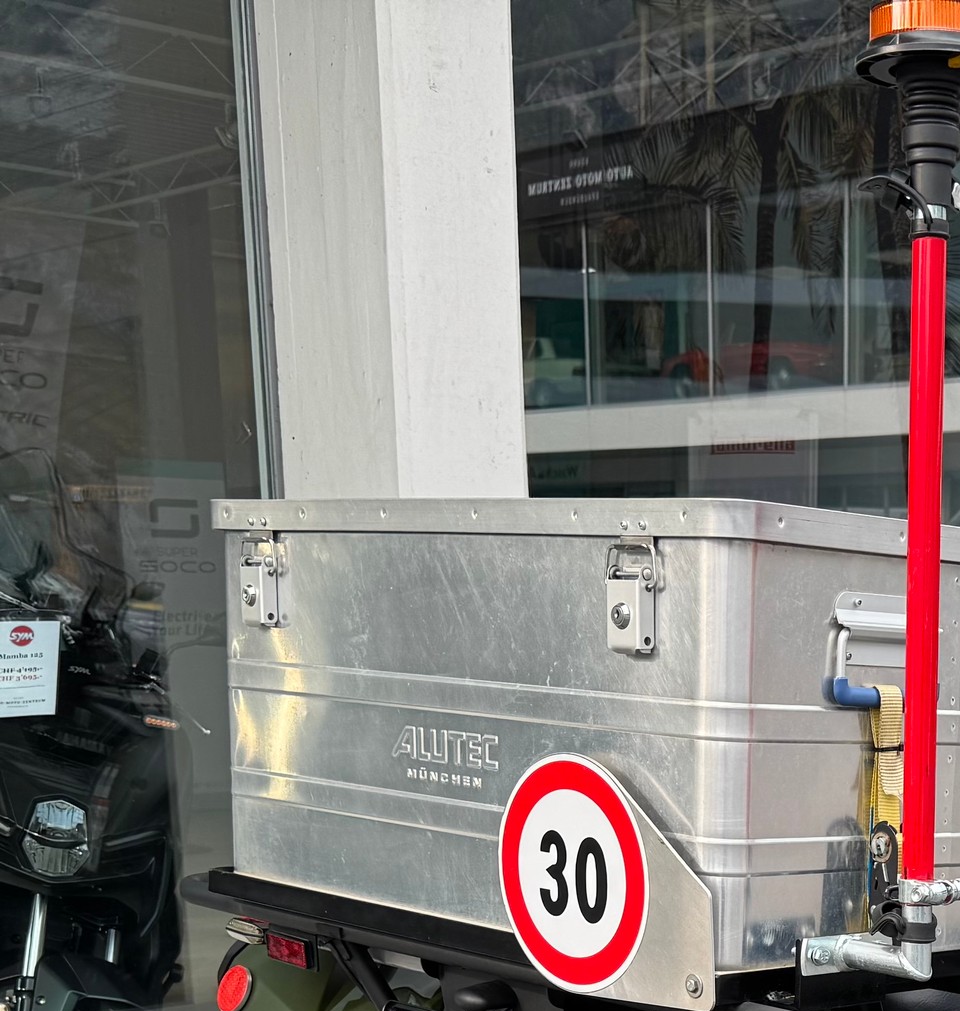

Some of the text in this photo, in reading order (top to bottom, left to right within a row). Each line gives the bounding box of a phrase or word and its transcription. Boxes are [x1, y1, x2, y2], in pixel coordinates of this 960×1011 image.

[139, 560, 216, 573] SOCO
[9, 632, 34, 642] SYM
[68, 665, 91, 675] SYM
[392, 725, 499, 772] ALUTEC
[407, 767, 483, 789] MÜNCHEN
[539, 829, 608, 924] 30
